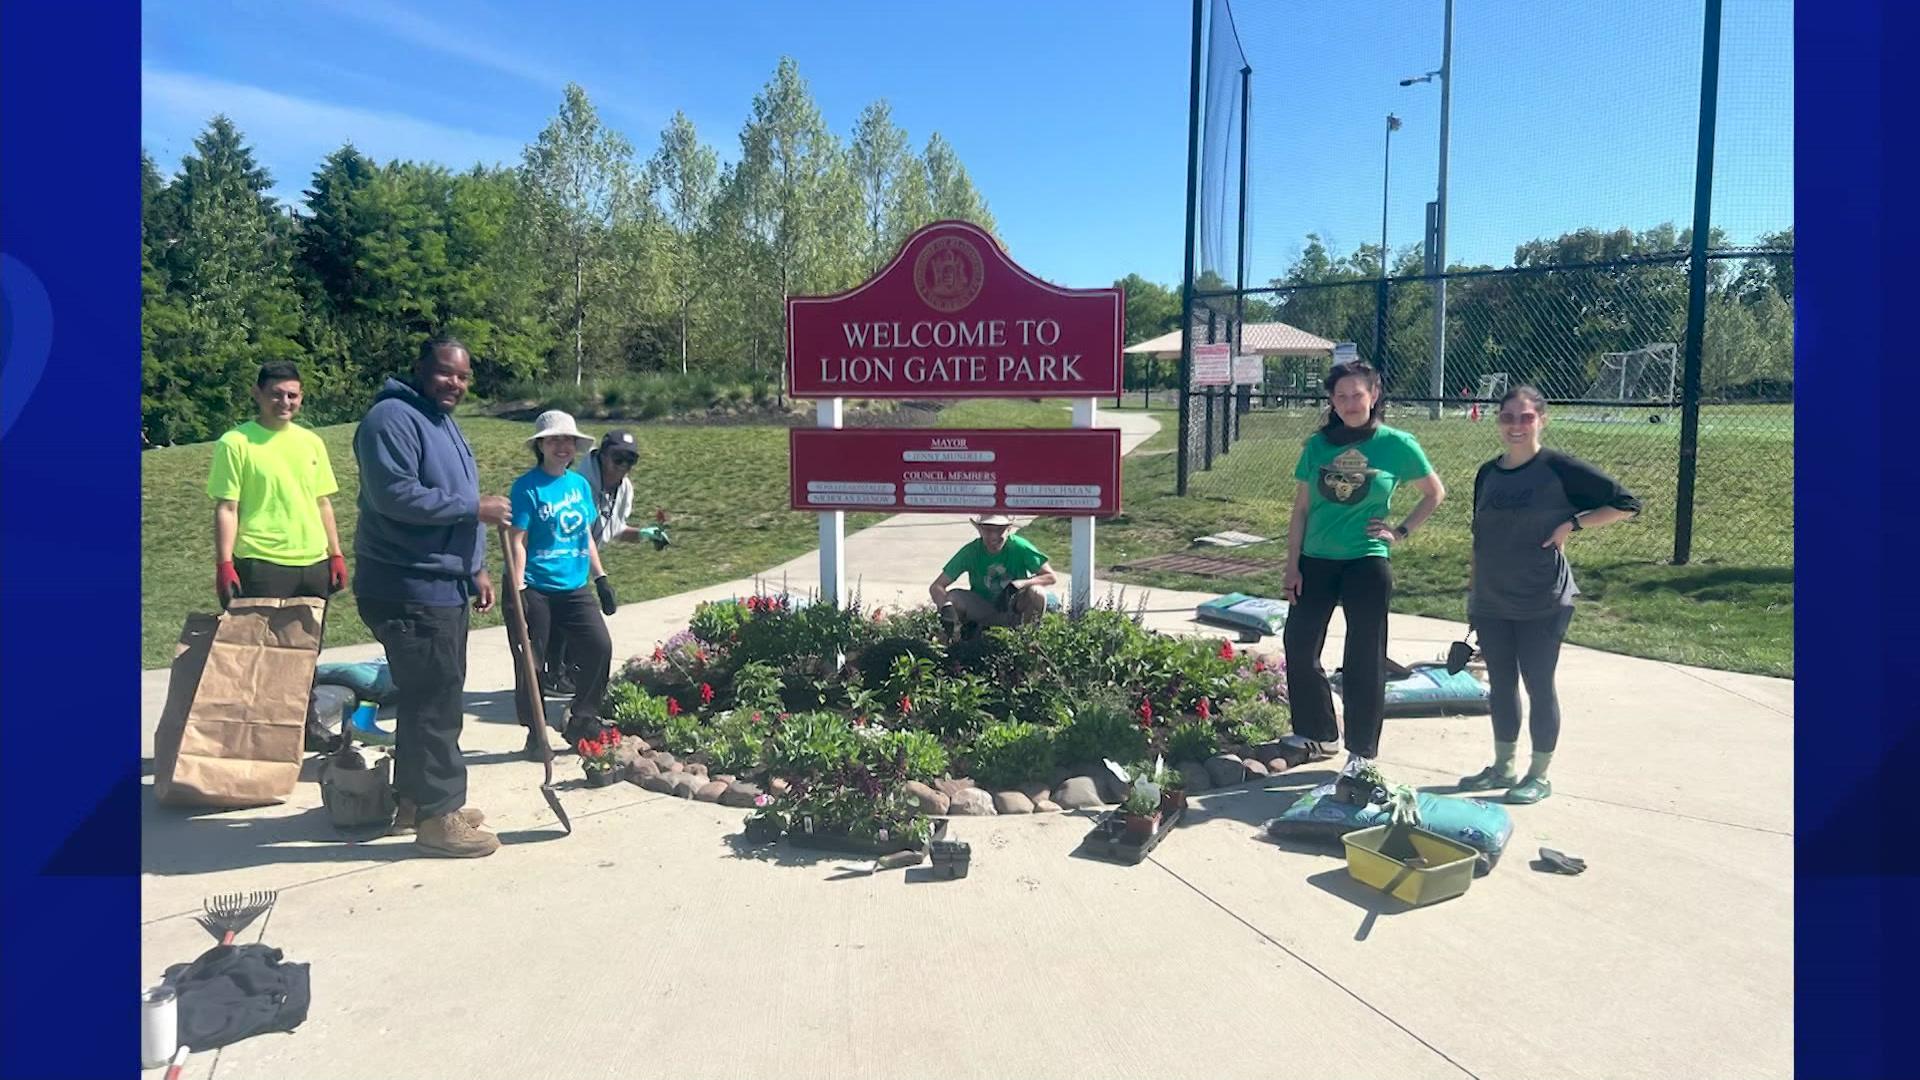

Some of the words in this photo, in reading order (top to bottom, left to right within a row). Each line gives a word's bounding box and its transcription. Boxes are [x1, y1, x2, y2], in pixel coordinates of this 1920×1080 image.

[841, 320, 1007, 349] WELCOME
[1015, 318, 1061, 346] TO
[819, 356, 894, 383] LION
[903, 355, 987, 383] GATE
[999, 354, 1084, 382] PARK
[931, 438, 967, 448] MAYOR
[902, 471, 946, 480] COUNCIL
[948, 471, 996, 480] MEMBERS
